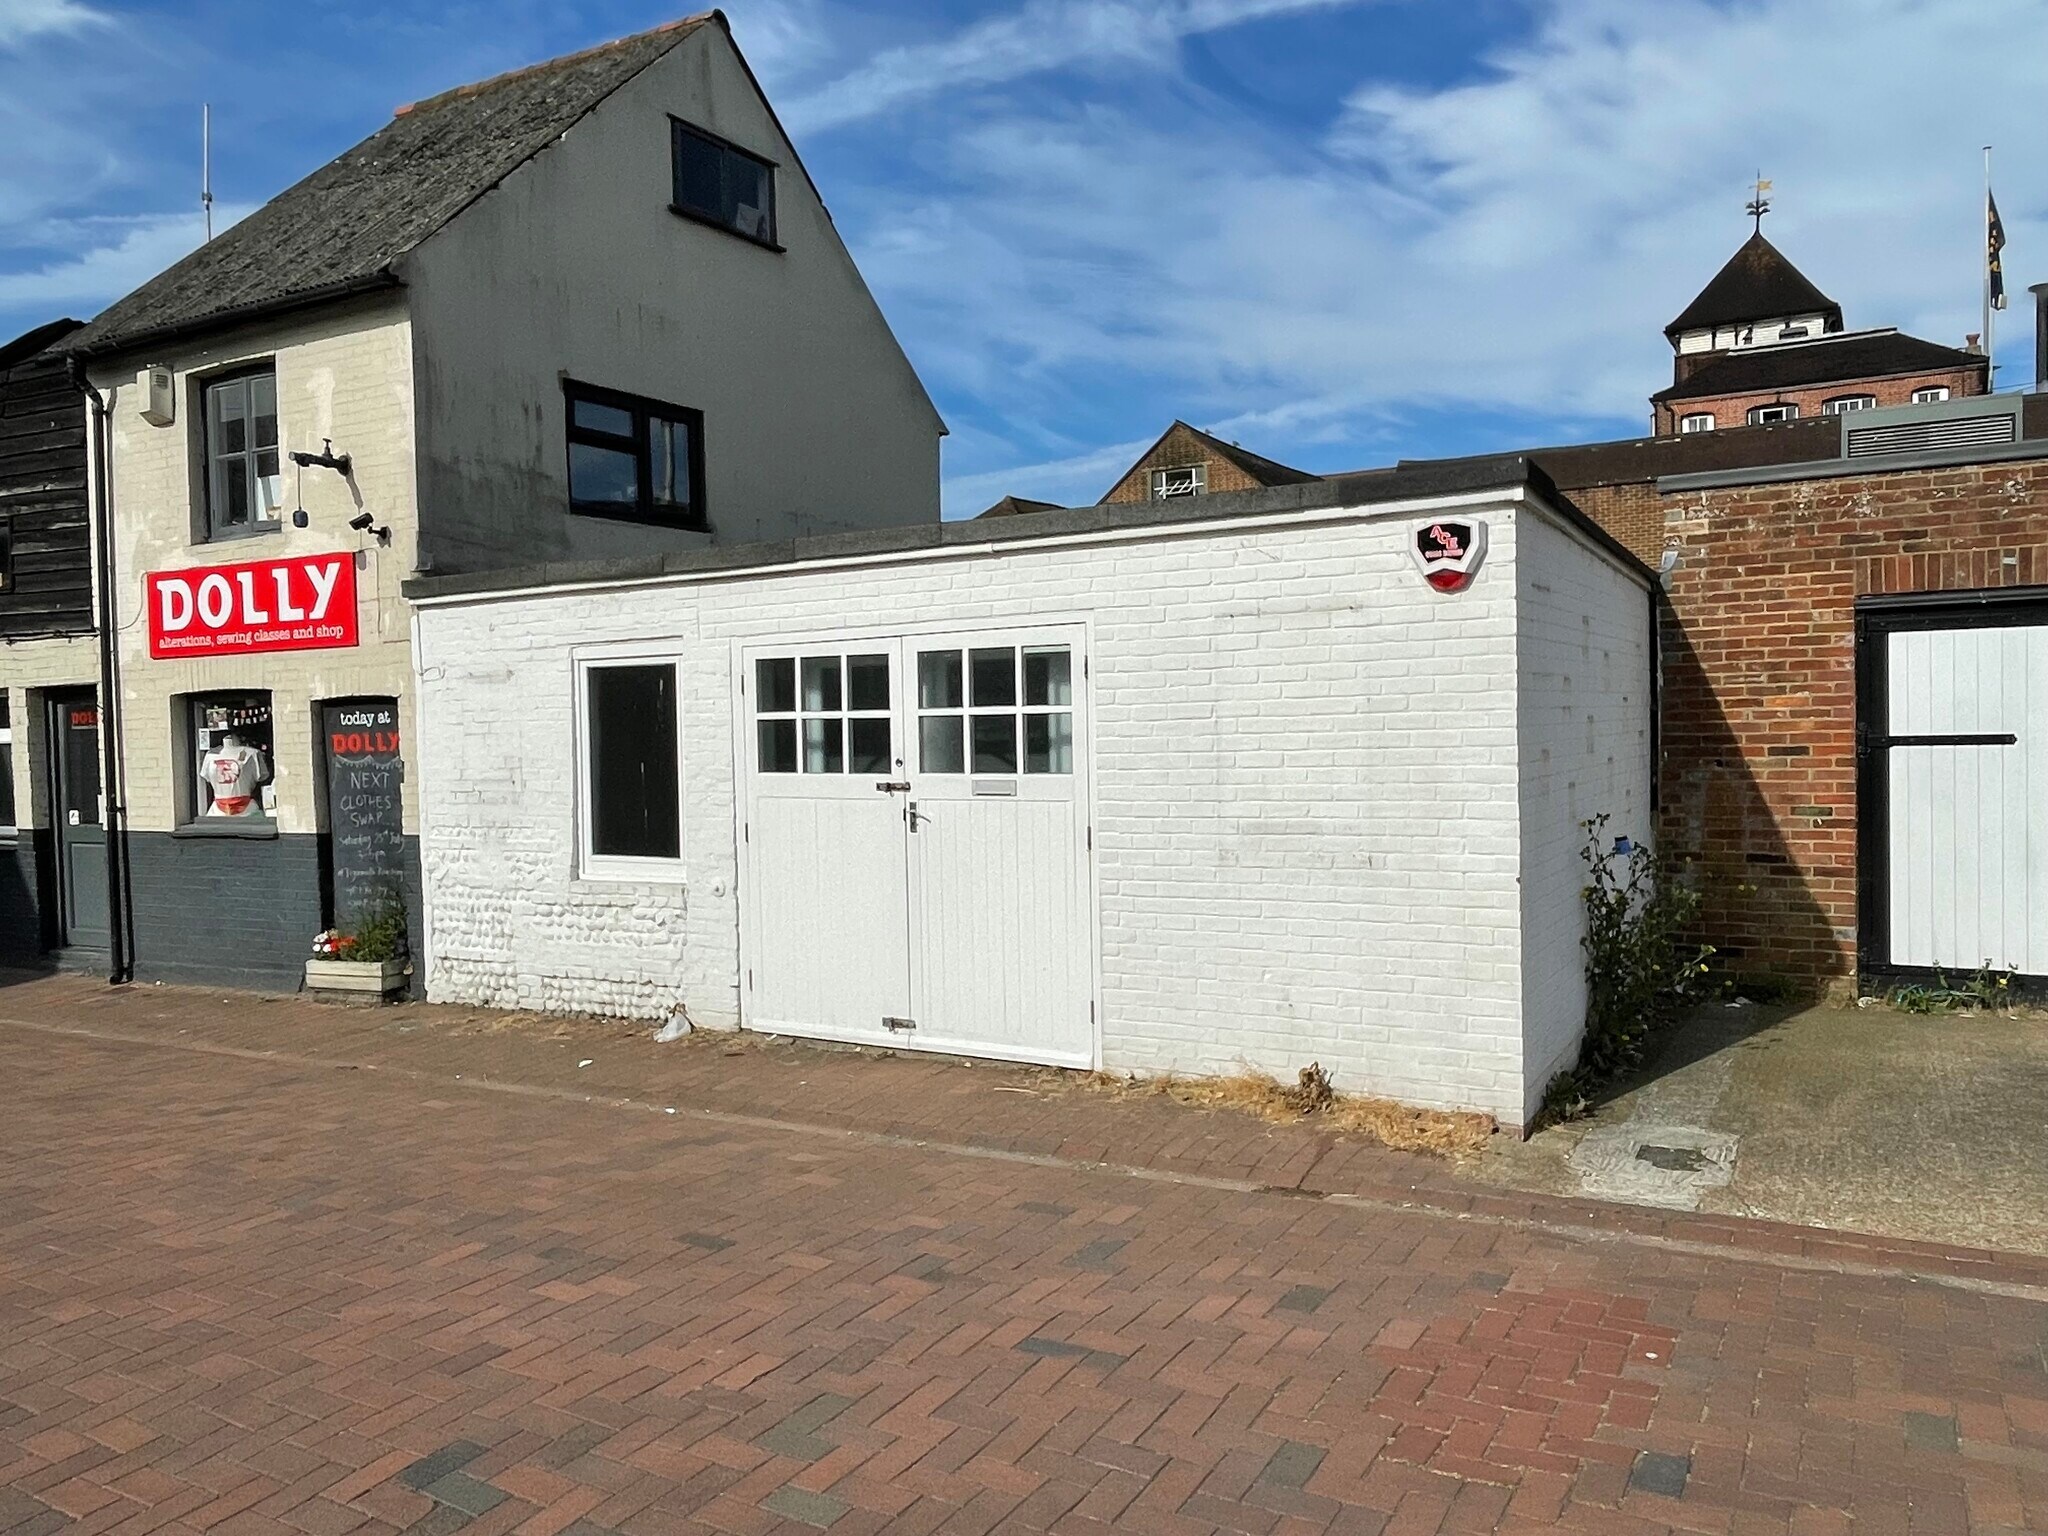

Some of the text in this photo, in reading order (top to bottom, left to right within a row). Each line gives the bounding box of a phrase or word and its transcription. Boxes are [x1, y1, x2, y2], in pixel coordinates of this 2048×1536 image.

[156, 562, 341, 631] DOLLY
[159, 624, 343, 650] alterations, sewing classes and shop
[340, 710, 391, 728] today at
[331, 731, 400, 754] DOLLY
[350, 772, 390, 789] NEXT
[340, 795, 392, 811] CLOTHES
